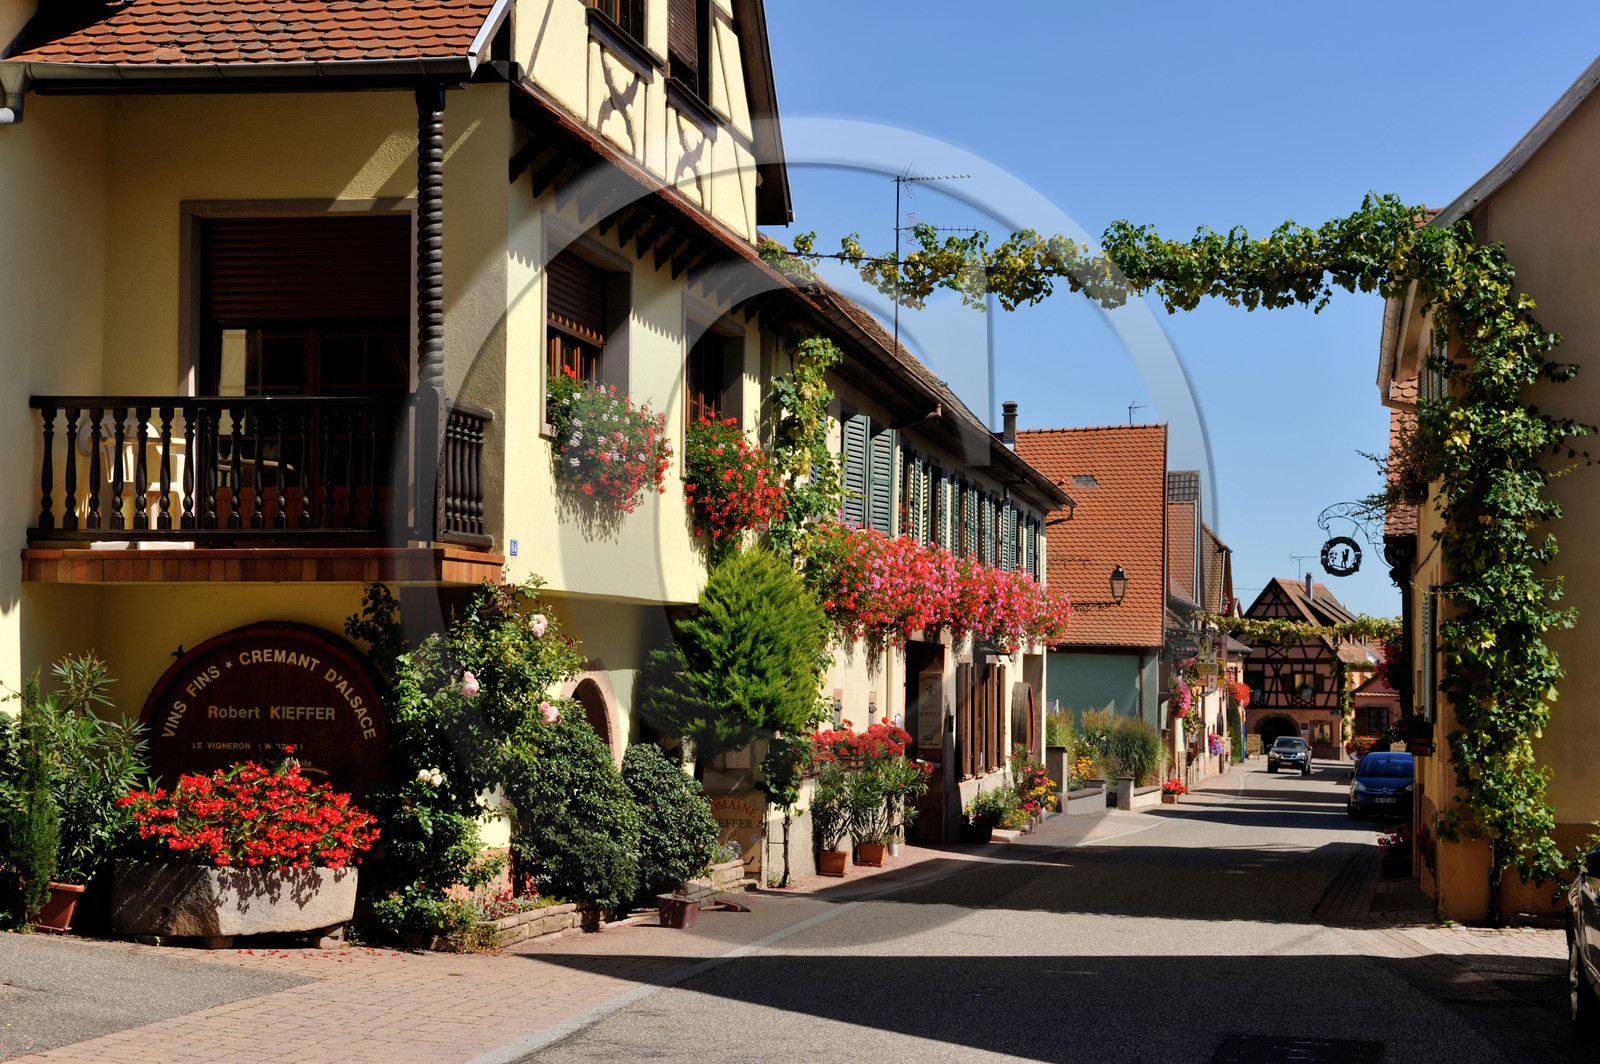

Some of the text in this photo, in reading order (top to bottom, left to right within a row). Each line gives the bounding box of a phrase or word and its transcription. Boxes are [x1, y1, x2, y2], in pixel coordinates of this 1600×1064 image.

[161, 649, 378, 741] VINS FINS CREMANT D'ALSACE
[207, 705, 336, 721] Robert KIEFFER
[192, 741, 203, 749] LE
[207, 742, 252, 751] VIGNERON
[710, 799, 759, 818] OMAINE
[718, 818, 753, 829] EFFER
